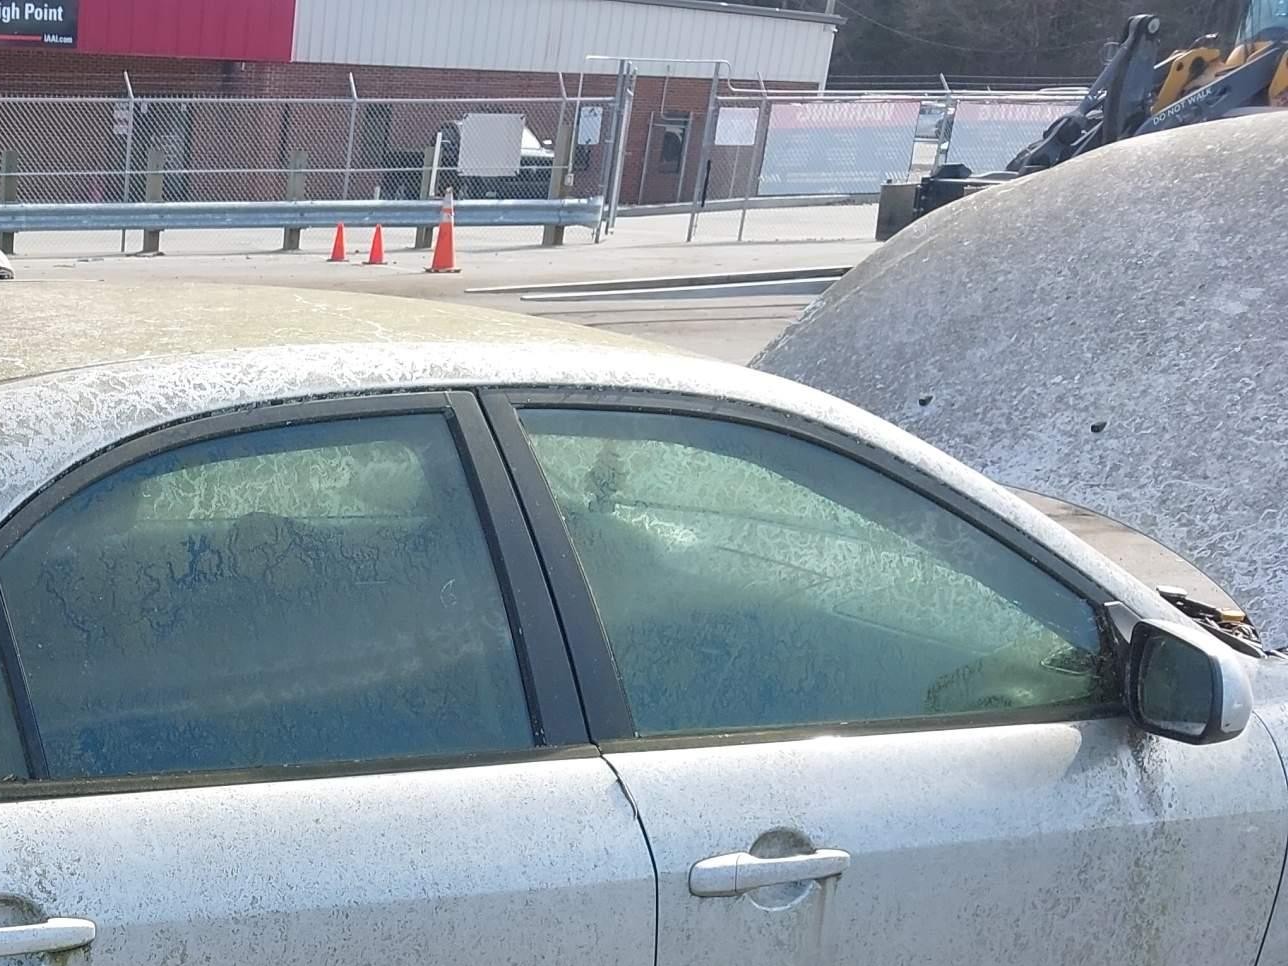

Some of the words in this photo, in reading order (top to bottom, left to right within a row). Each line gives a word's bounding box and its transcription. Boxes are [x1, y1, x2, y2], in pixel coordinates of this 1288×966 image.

[24, 3, 64, 22] Point
[1153, 113, 1166, 126] DO
[1167, 101, 1186, 117] NOT
[1187, 88, 1212, 105] WALK
